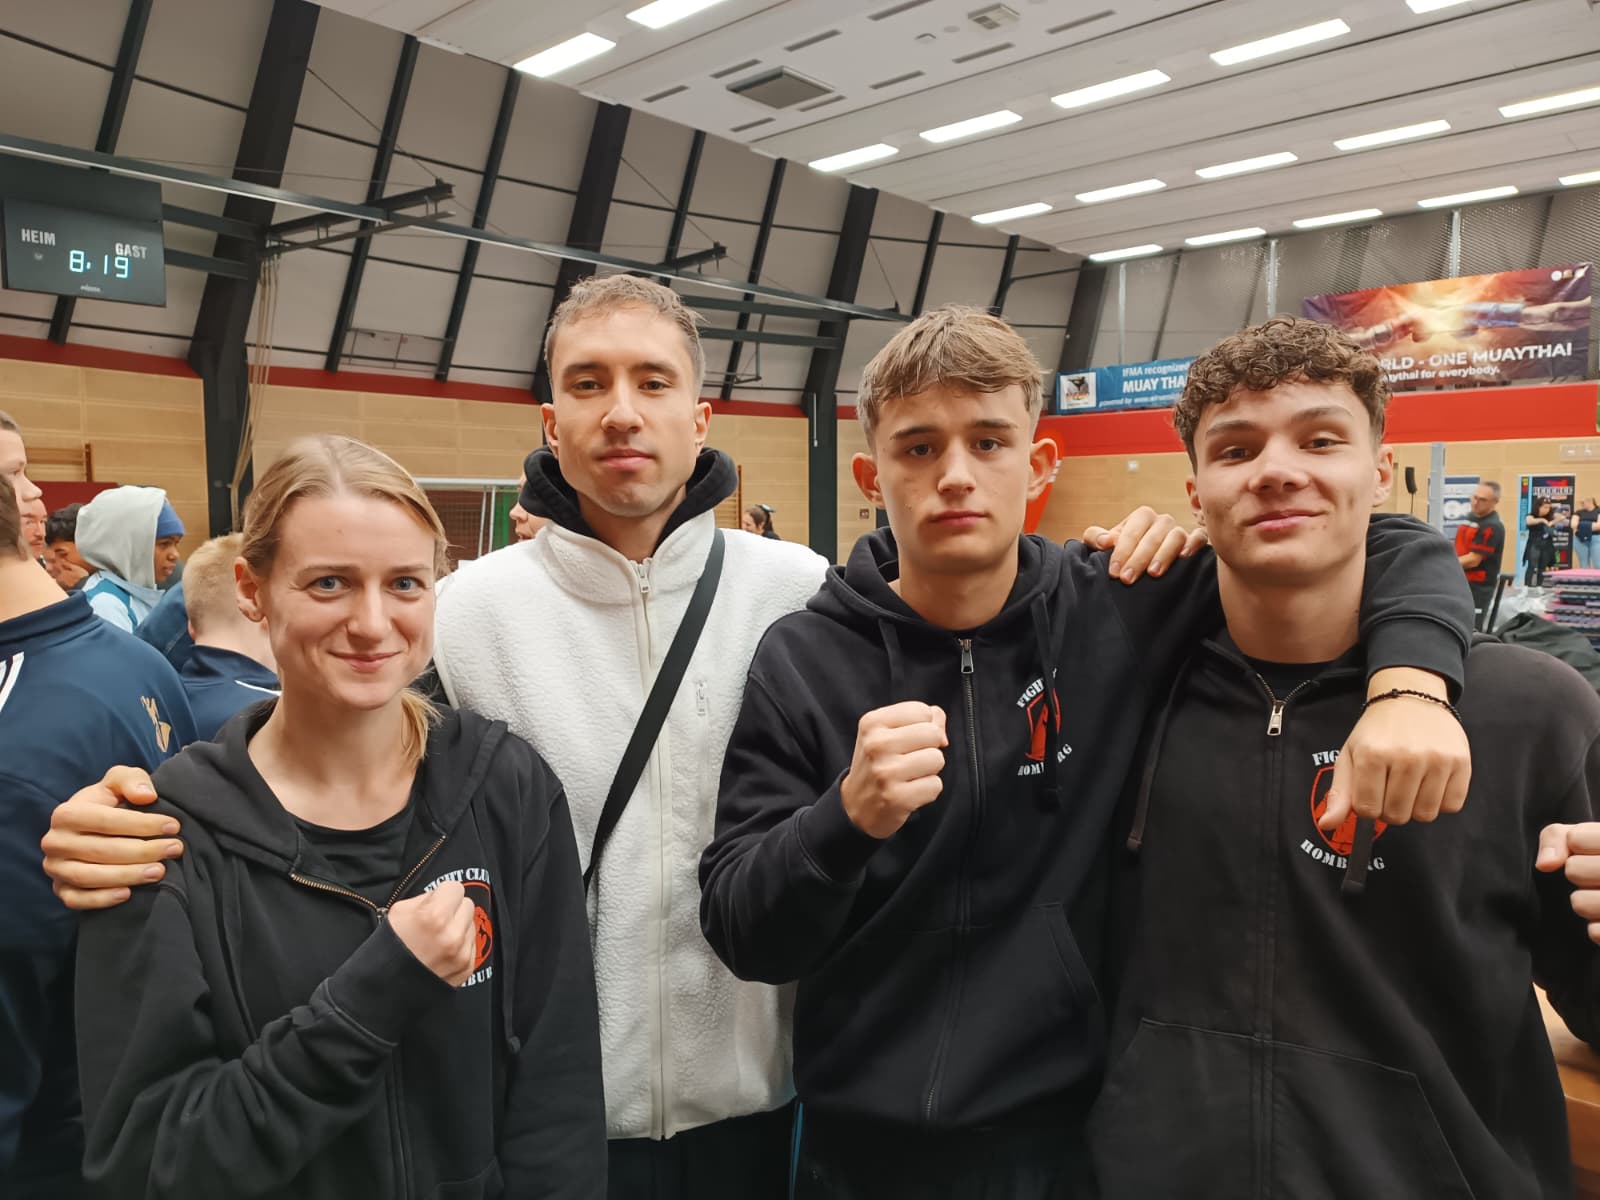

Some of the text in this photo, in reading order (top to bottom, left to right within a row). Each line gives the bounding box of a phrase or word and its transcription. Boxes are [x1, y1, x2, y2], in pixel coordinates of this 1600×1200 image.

[21, 228, 56, 246] HEIM
[115, 242, 147, 259] GAST
[1380, 356, 1414, 371] RLD
[1429, 352, 1468, 367] ONE
[1472, 342, 1573, 364] MUAYTHAI
[1421, 370, 1437, 379] for
[1438, 365, 1500, 379] everybody.
[1123, 378, 1159, 393] MUAY
[1312, 749, 1340, 767] FIG
